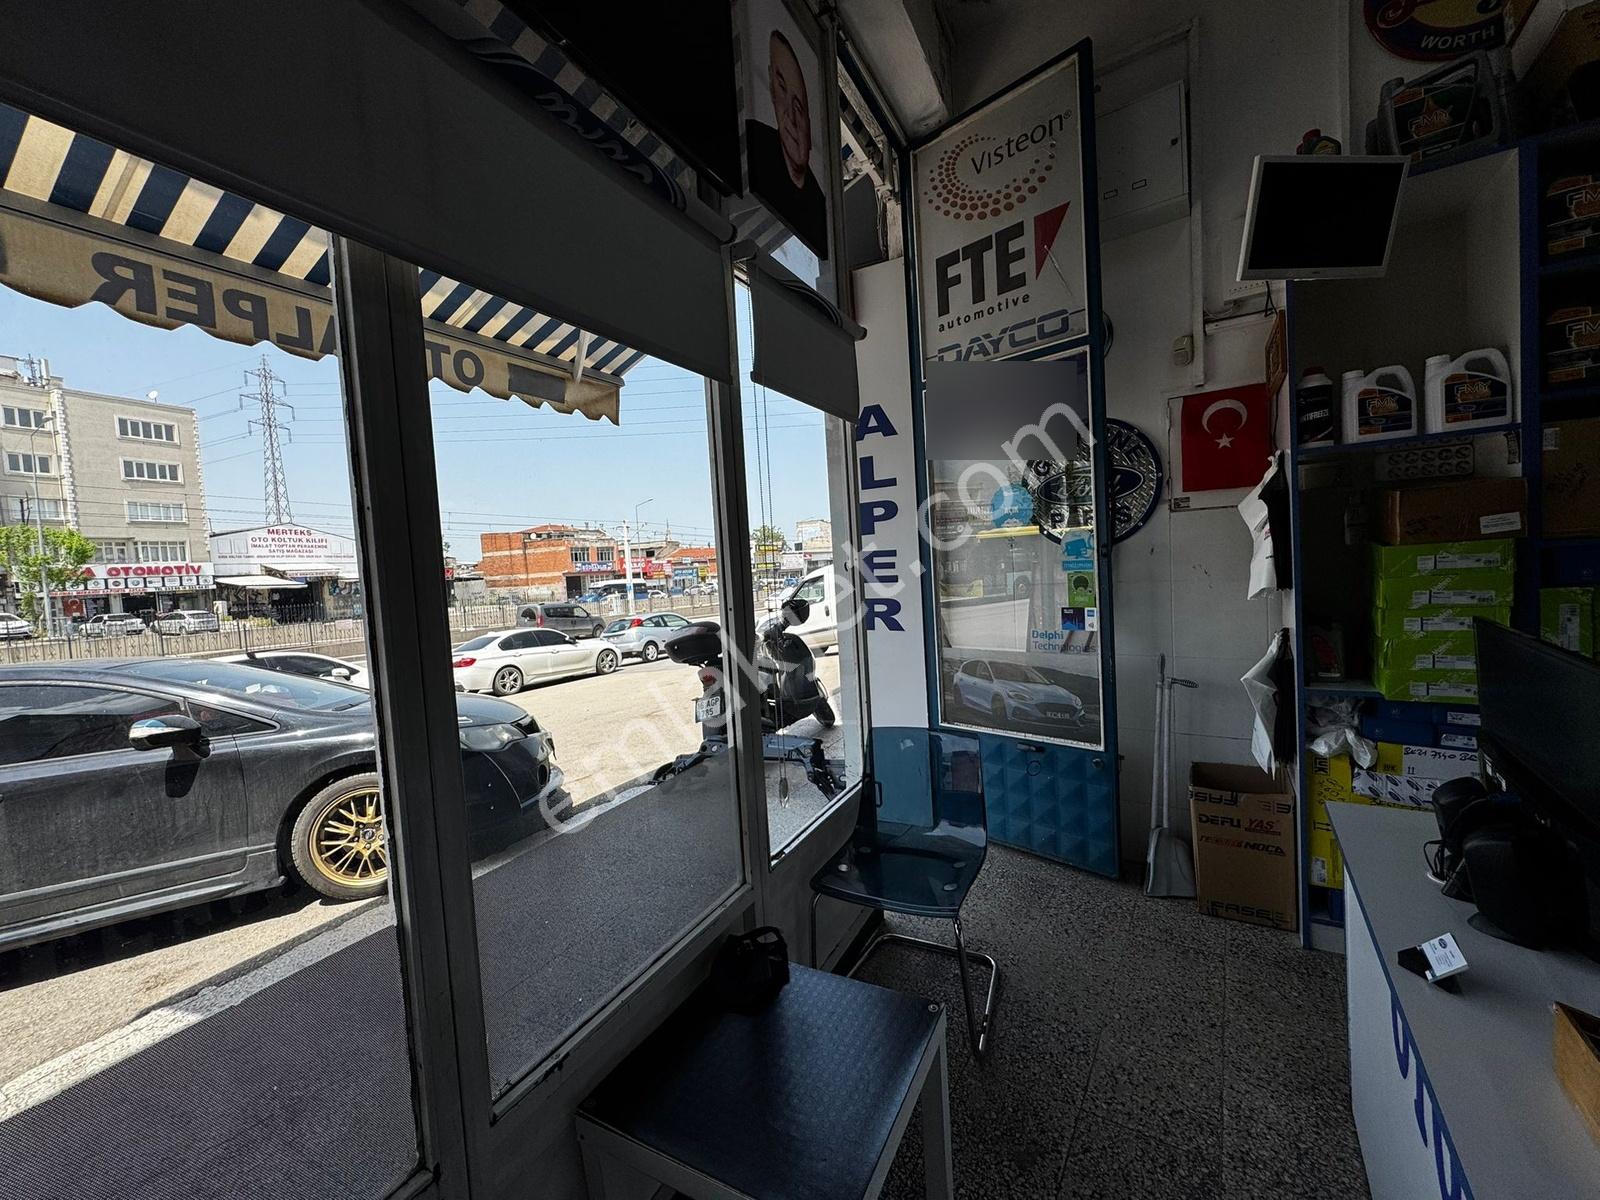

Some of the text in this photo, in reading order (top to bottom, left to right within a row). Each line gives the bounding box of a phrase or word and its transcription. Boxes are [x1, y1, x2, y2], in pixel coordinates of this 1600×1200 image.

[1421, 25, 1495, 49] WORTH
[936, 221, 1026, 317] FTE
[938, 293, 1029, 332] automotive
[856, 403, 906, 632] ALPER
[267, 528, 312, 537] MERTEKS
[107, 563, 201, 576] OTOMOTİV
[1032, 630, 1064, 640] Delphi
[1033, 641, 1096, 653] Technologies
